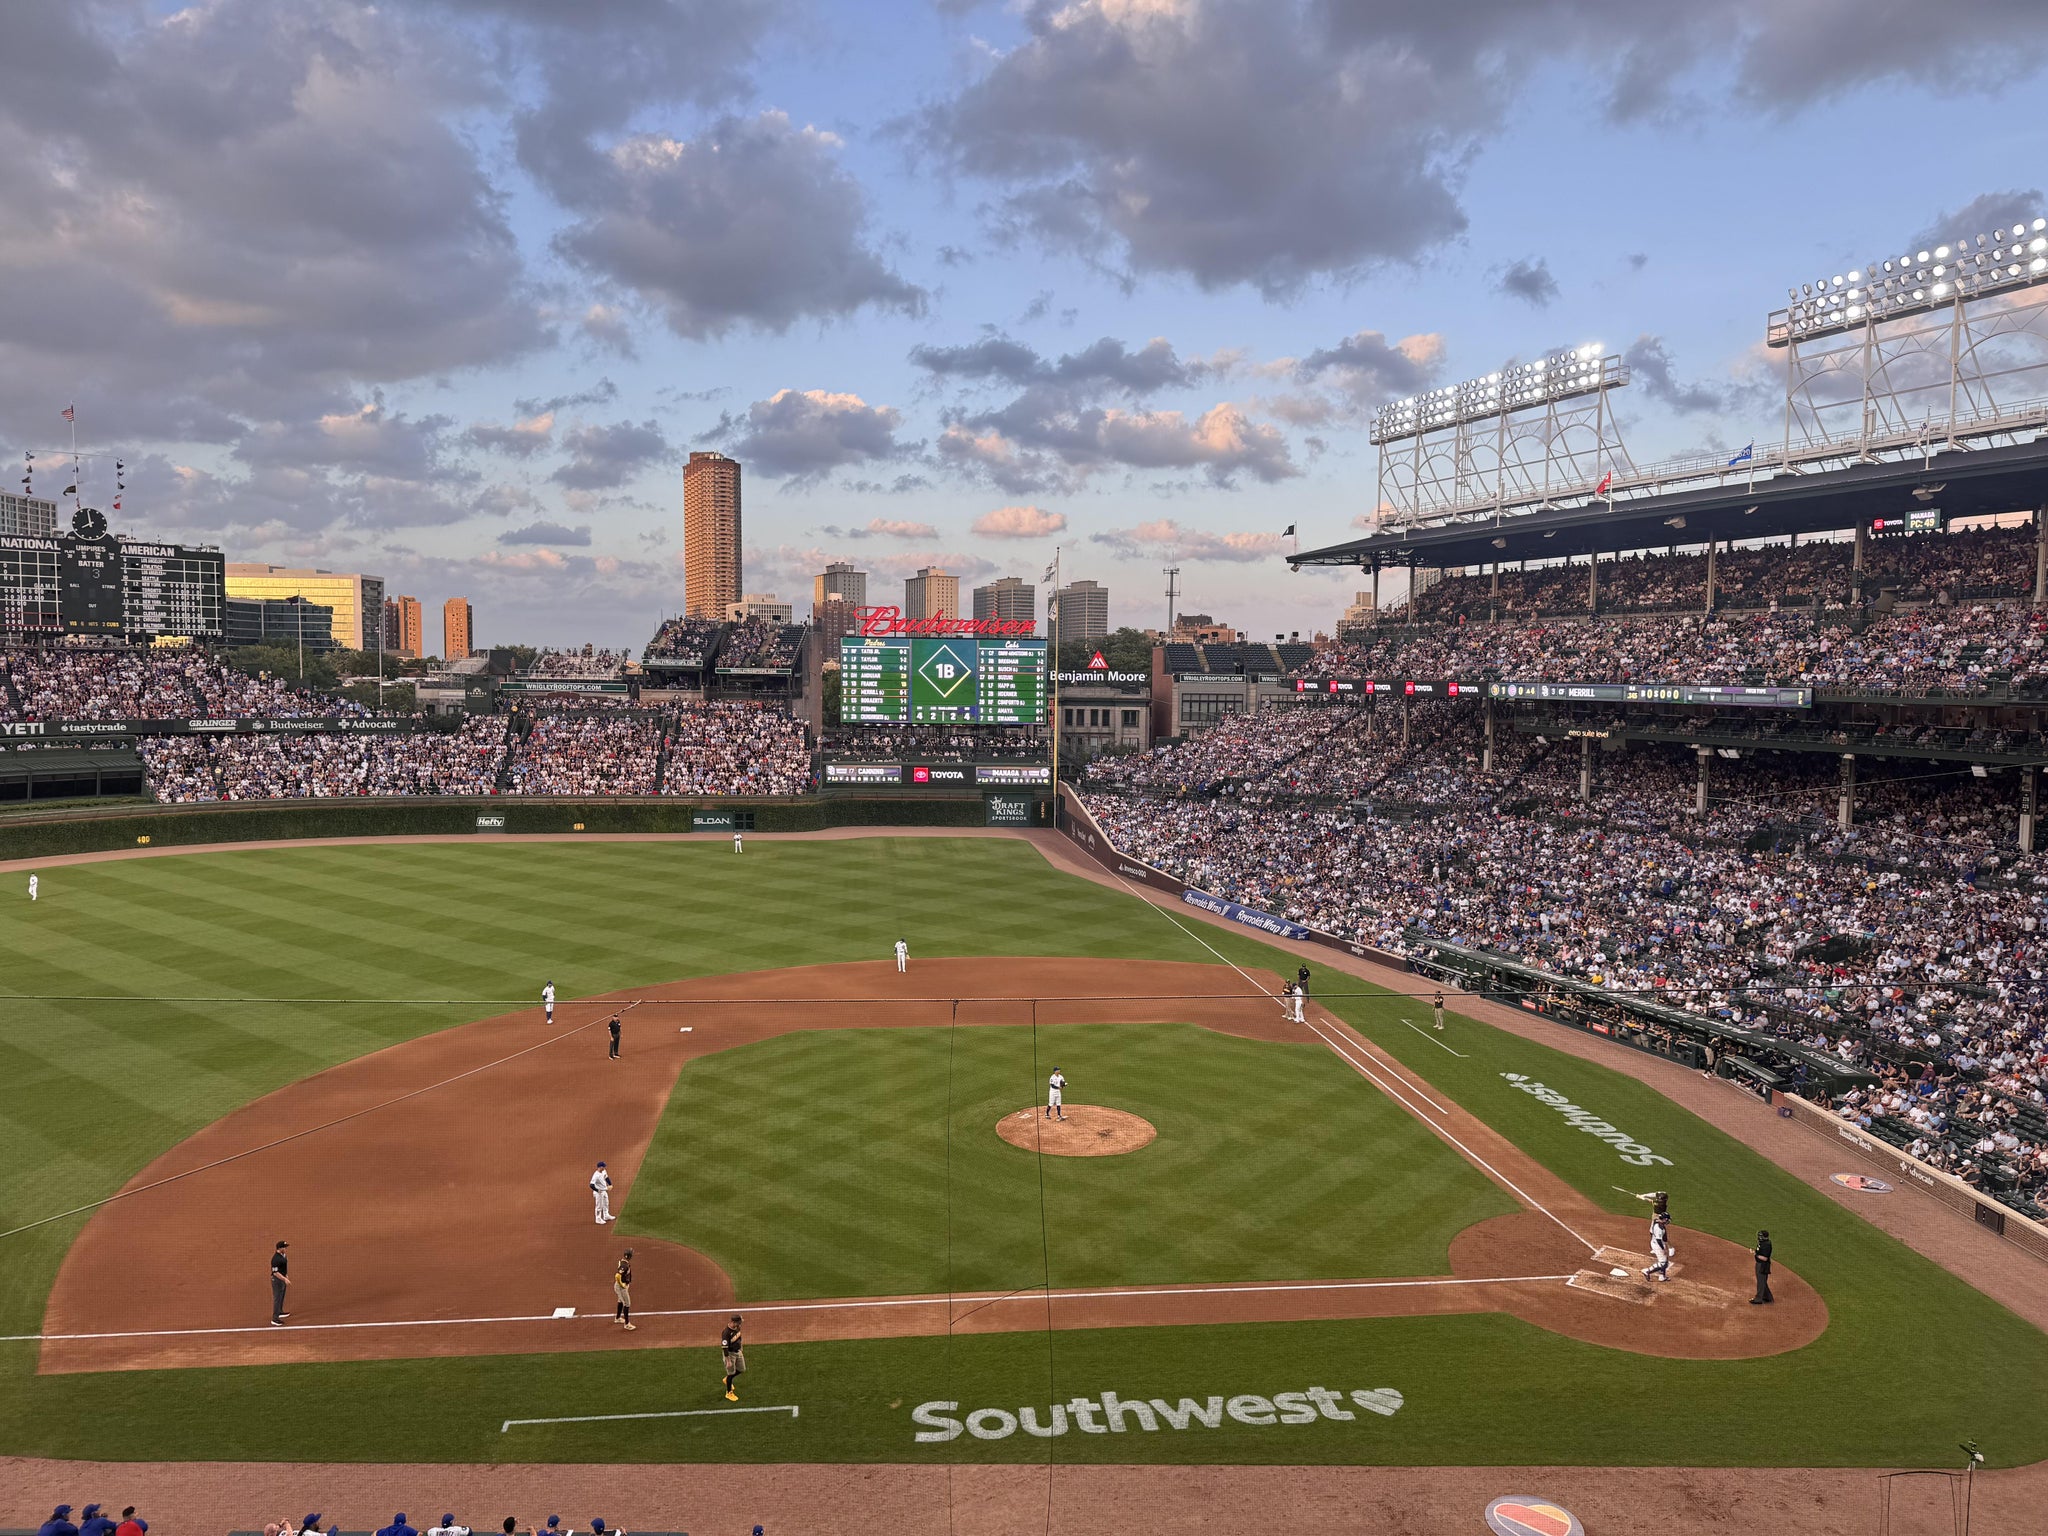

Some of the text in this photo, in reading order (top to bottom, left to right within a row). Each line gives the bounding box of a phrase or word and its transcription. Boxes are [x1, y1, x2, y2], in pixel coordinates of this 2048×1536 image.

[1911, 518, 1935, 528] PC: 49
[1, 538, 61, 550] NATIONAL
[120, 544, 174, 557] AMERICAN
[92, 568, 100, 578] 3
[853, 606, 1037, 636] Budweiser
[936, 664, 955, 678] 1B
[1050, 670, 1146, 683] Benjamin Moore
[1518, 687, 1523, 695] 0
[1568, 688, 1595, 697] MERRILL
[1647, 689, 1652, 699] 0
[1660, 689, 1666, 699] 0
[1673, 690, 1679, 699] 0
[1, 722, 45, 735] YETI
[70, 723, 126, 734] tastytrade
[352, 720, 397, 728] Advocate
[992, 801, 1025, 811] DRAFT
[1185, 893, 1222, 914] Reynolds Wrap
[1236, 910, 1280, 934] Reynolds Wrap
[1509, 1081, 1674, 1166] Southwest
[1838, 1127, 1872, 1152] TimberTech
[912, 1386, 1356, 1442] Southwest
